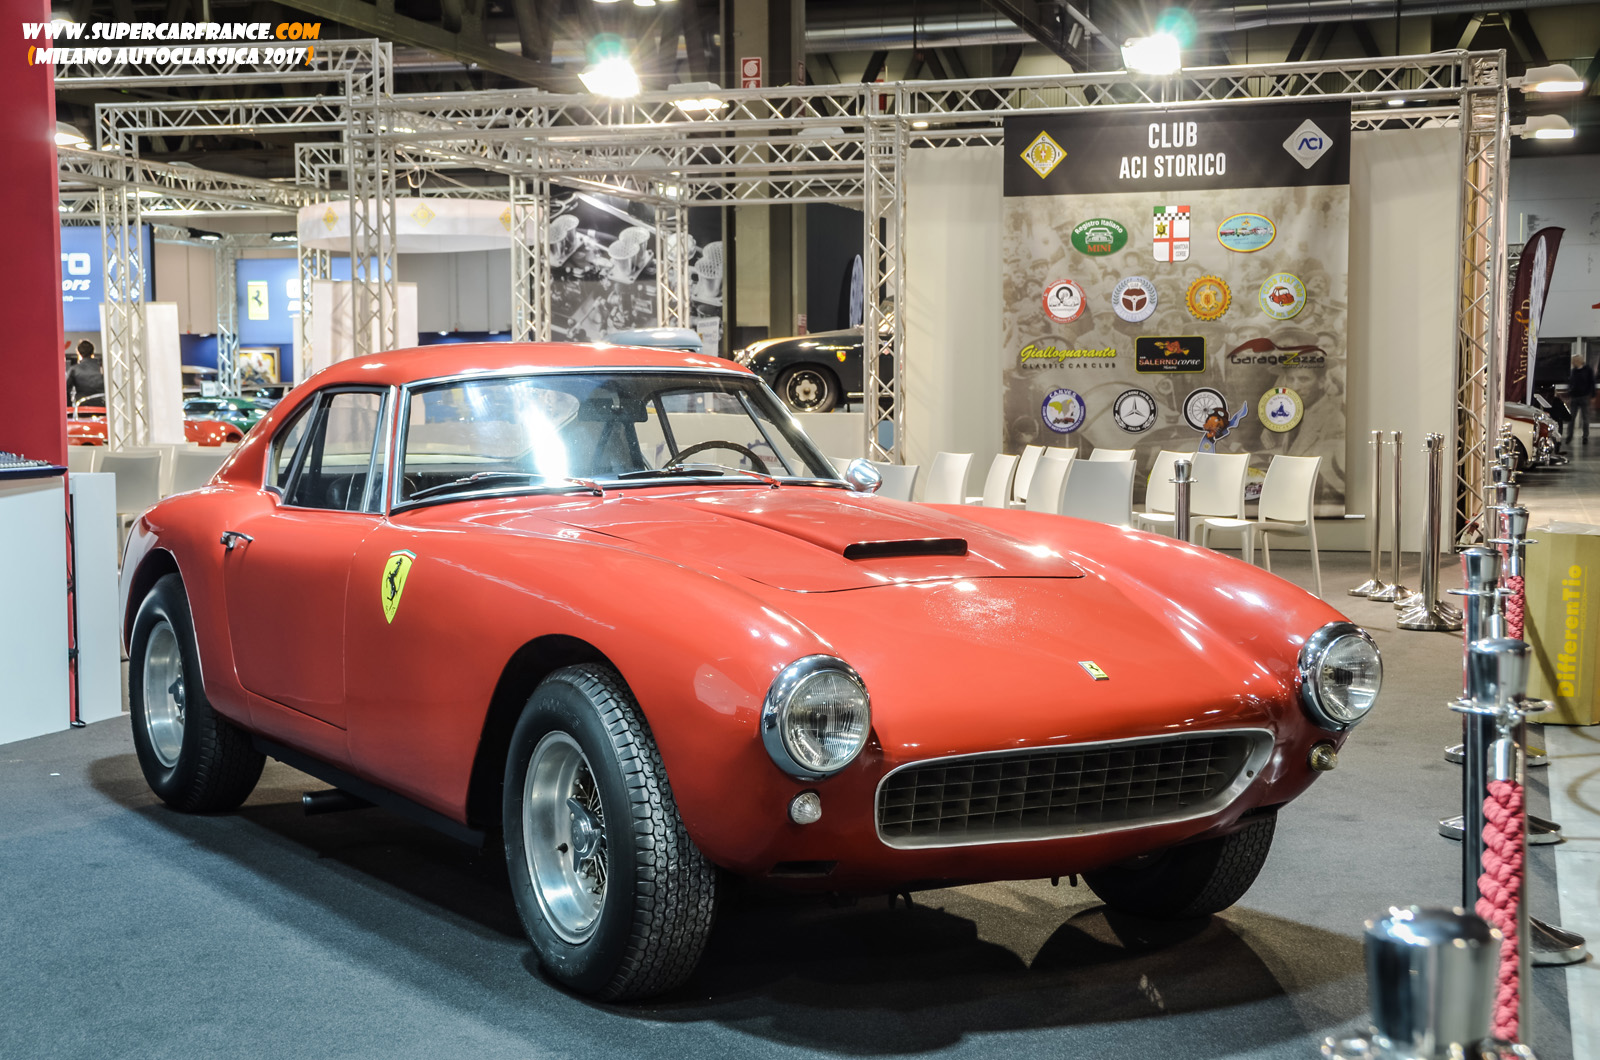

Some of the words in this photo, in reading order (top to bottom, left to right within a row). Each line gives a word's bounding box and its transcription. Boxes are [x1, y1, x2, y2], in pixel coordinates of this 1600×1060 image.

[1148, 121, 1198, 149] CLUB
[1297, 137, 1323, 151] ACI
[1119, 156, 1147, 179] ACI
[1154, 152, 1226, 178] STORICO
[1074, 220, 1099, 234] Registro
[1100, 219, 1123, 234] Italiano
[1087, 244, 1112, 252] MINI
[1021, 344, 1117, 362] Gialloquaranta
[1556, 564, 1582, 697] DifferenTio
